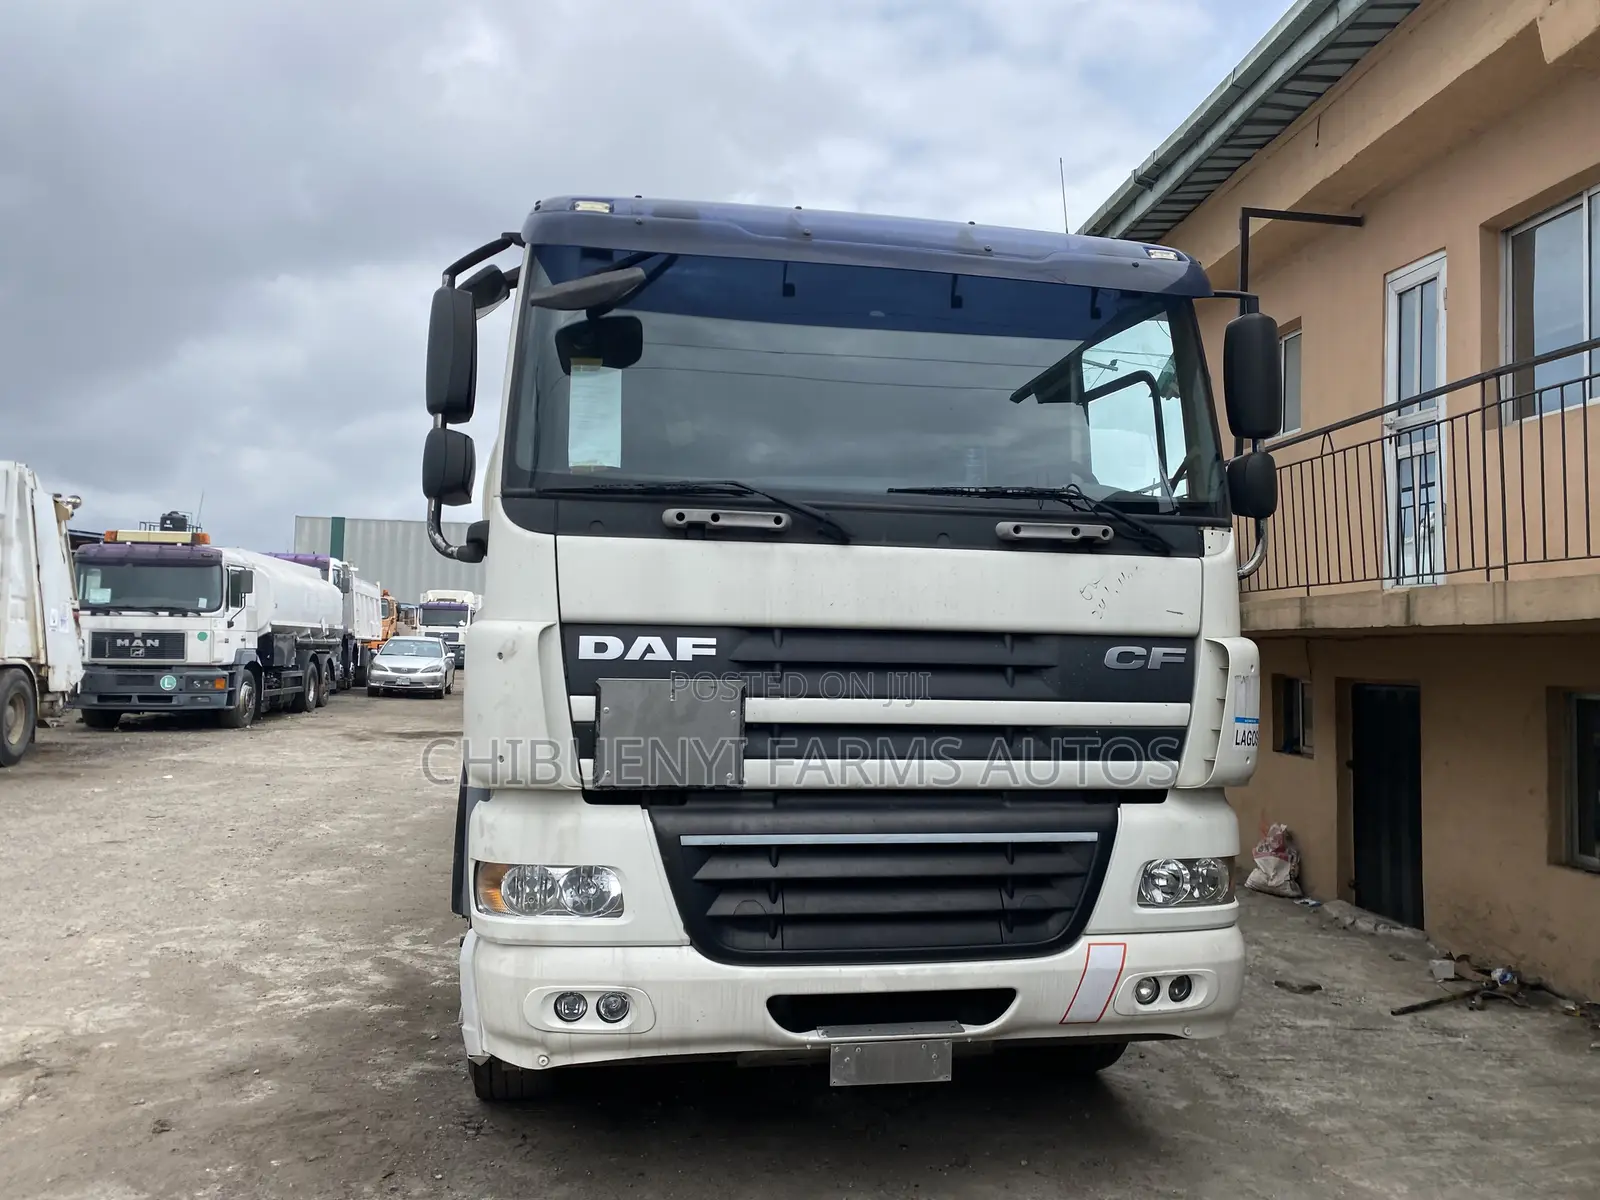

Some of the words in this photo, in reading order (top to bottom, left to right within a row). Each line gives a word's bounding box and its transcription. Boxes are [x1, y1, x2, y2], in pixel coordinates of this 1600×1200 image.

[117, 639, 160, 647] MAN
[578, 635, 717, 660] DAF
[1103, 646, 1187, 670] CF
